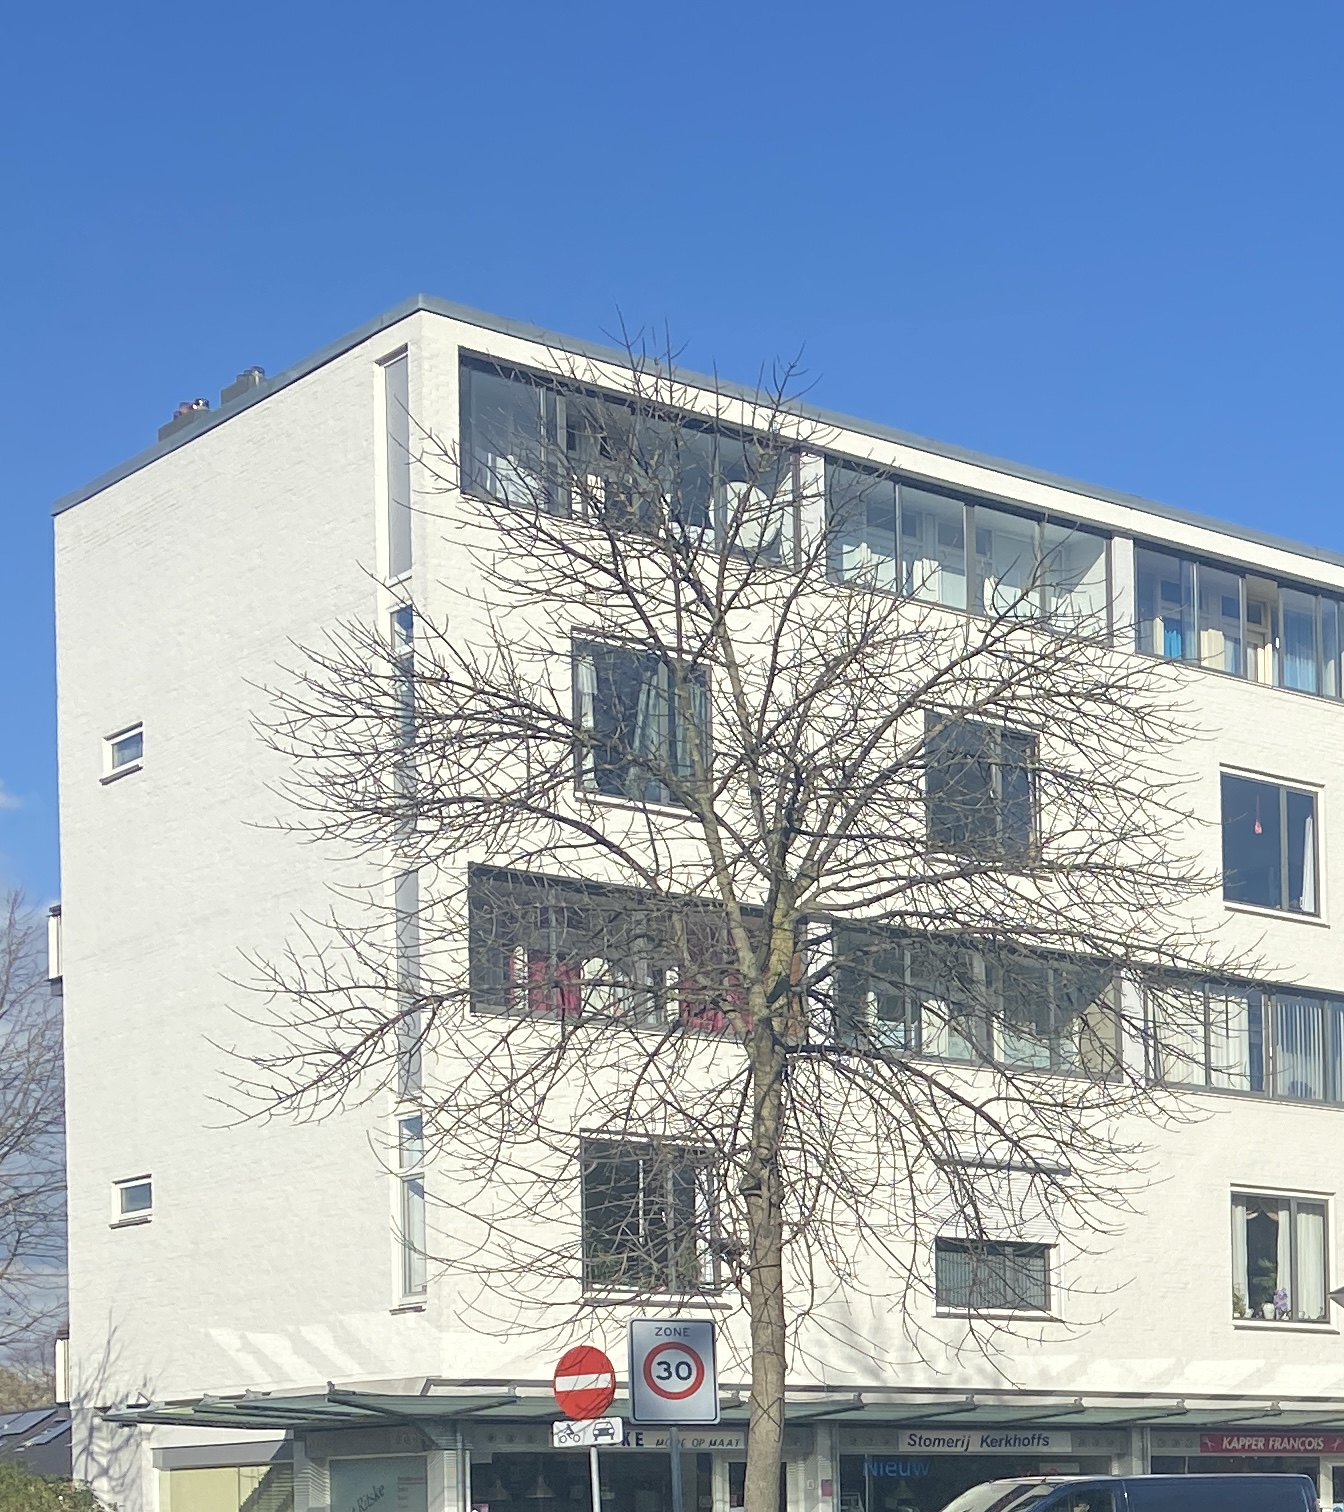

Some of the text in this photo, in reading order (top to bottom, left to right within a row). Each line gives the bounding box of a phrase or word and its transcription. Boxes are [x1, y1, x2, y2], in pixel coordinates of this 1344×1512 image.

[655, 1327, 691, 1337] ZONE
[656, 1361, 693, 1381] 30
[692, 1438, 705, 1448] OP
[709, 1438, 741, 1448] MAAT
[908, 1433, 1050, 1452] Stomerij Kerkhoffs
[1222, 1436, 1325, 1452] KAPPER FRANÇOIS
